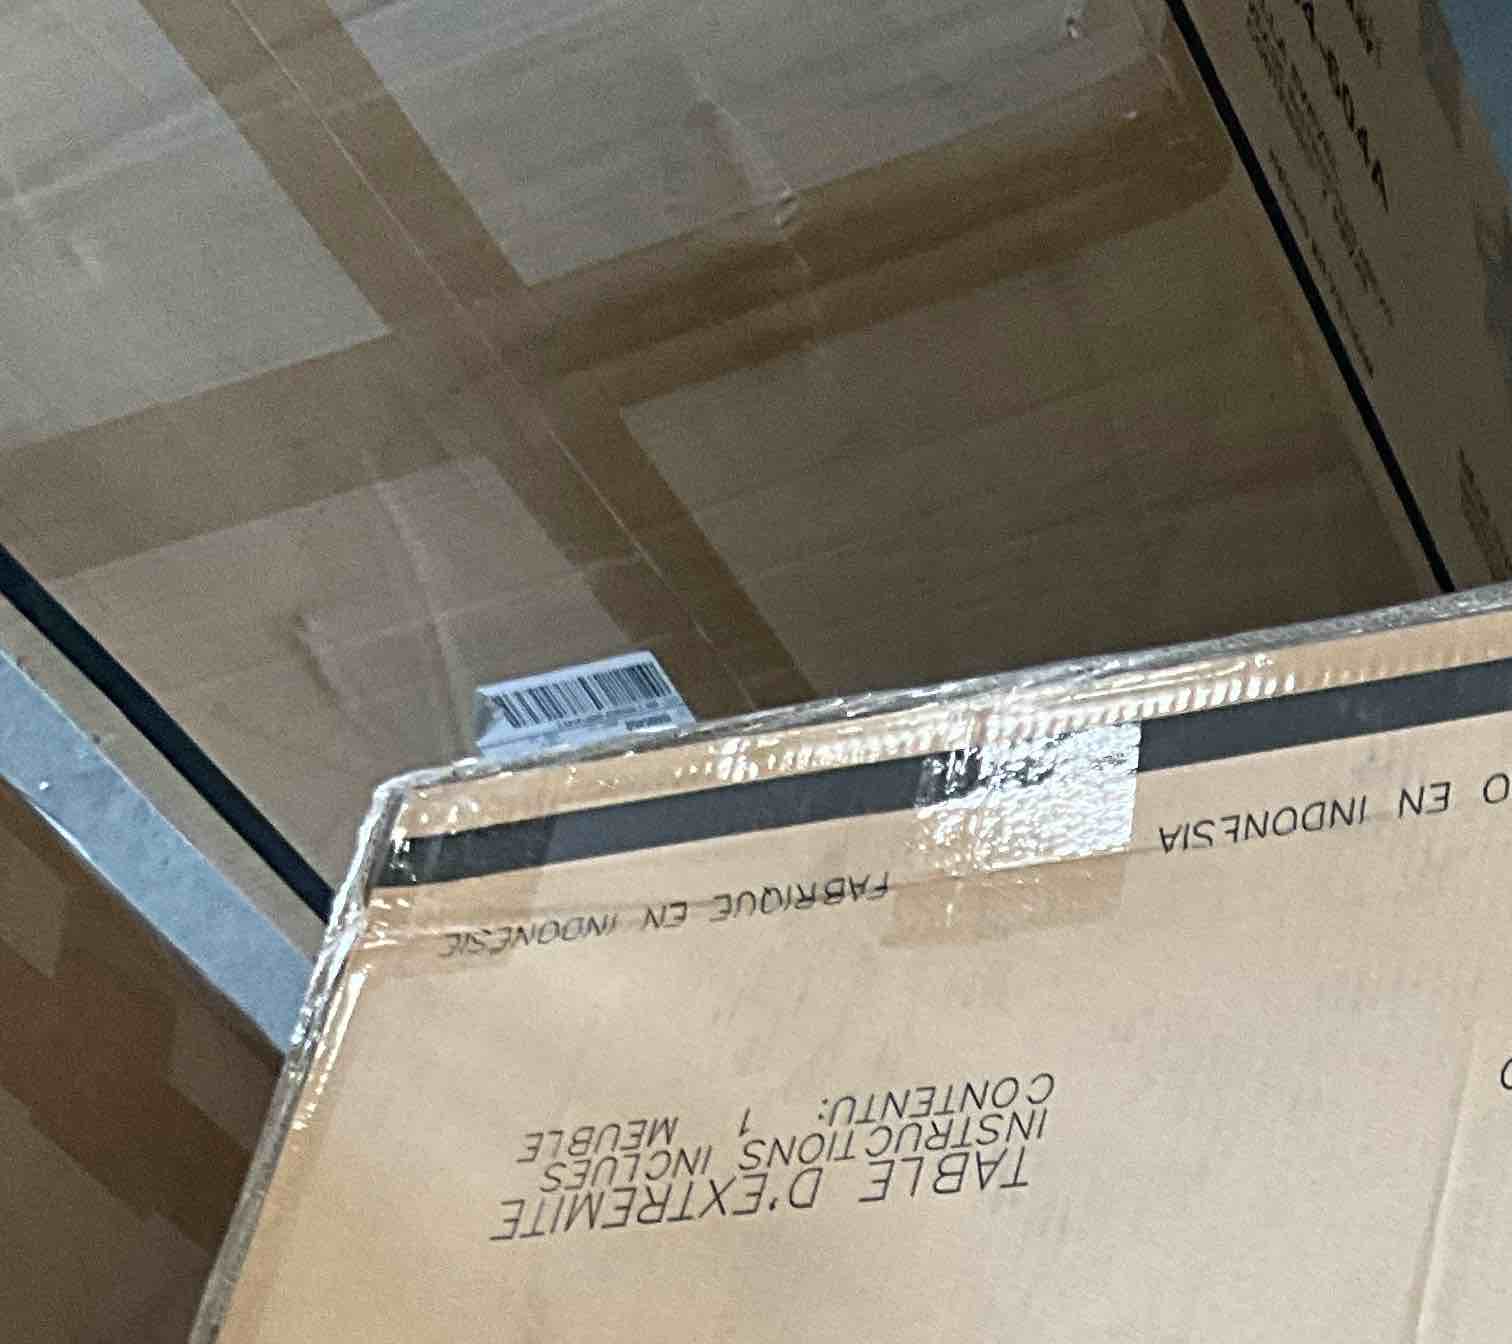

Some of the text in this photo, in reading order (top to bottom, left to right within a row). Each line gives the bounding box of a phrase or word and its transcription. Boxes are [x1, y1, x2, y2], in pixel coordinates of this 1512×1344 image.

[1159, 795, 1368, 854] INDONESIA
[1399, 781, 1451, 817] EN
[438, 871, 889, 958] FABRIQUE EN INDONESIE
[516, 1073, 1055, 1162] CONTENTU: 1 MEUBLE
[540, 1108, 1047, 1193] INSTRUCTIONS INCLUES
[490, 1145, 1029, 1241] TABLE D'EXTREMITE
